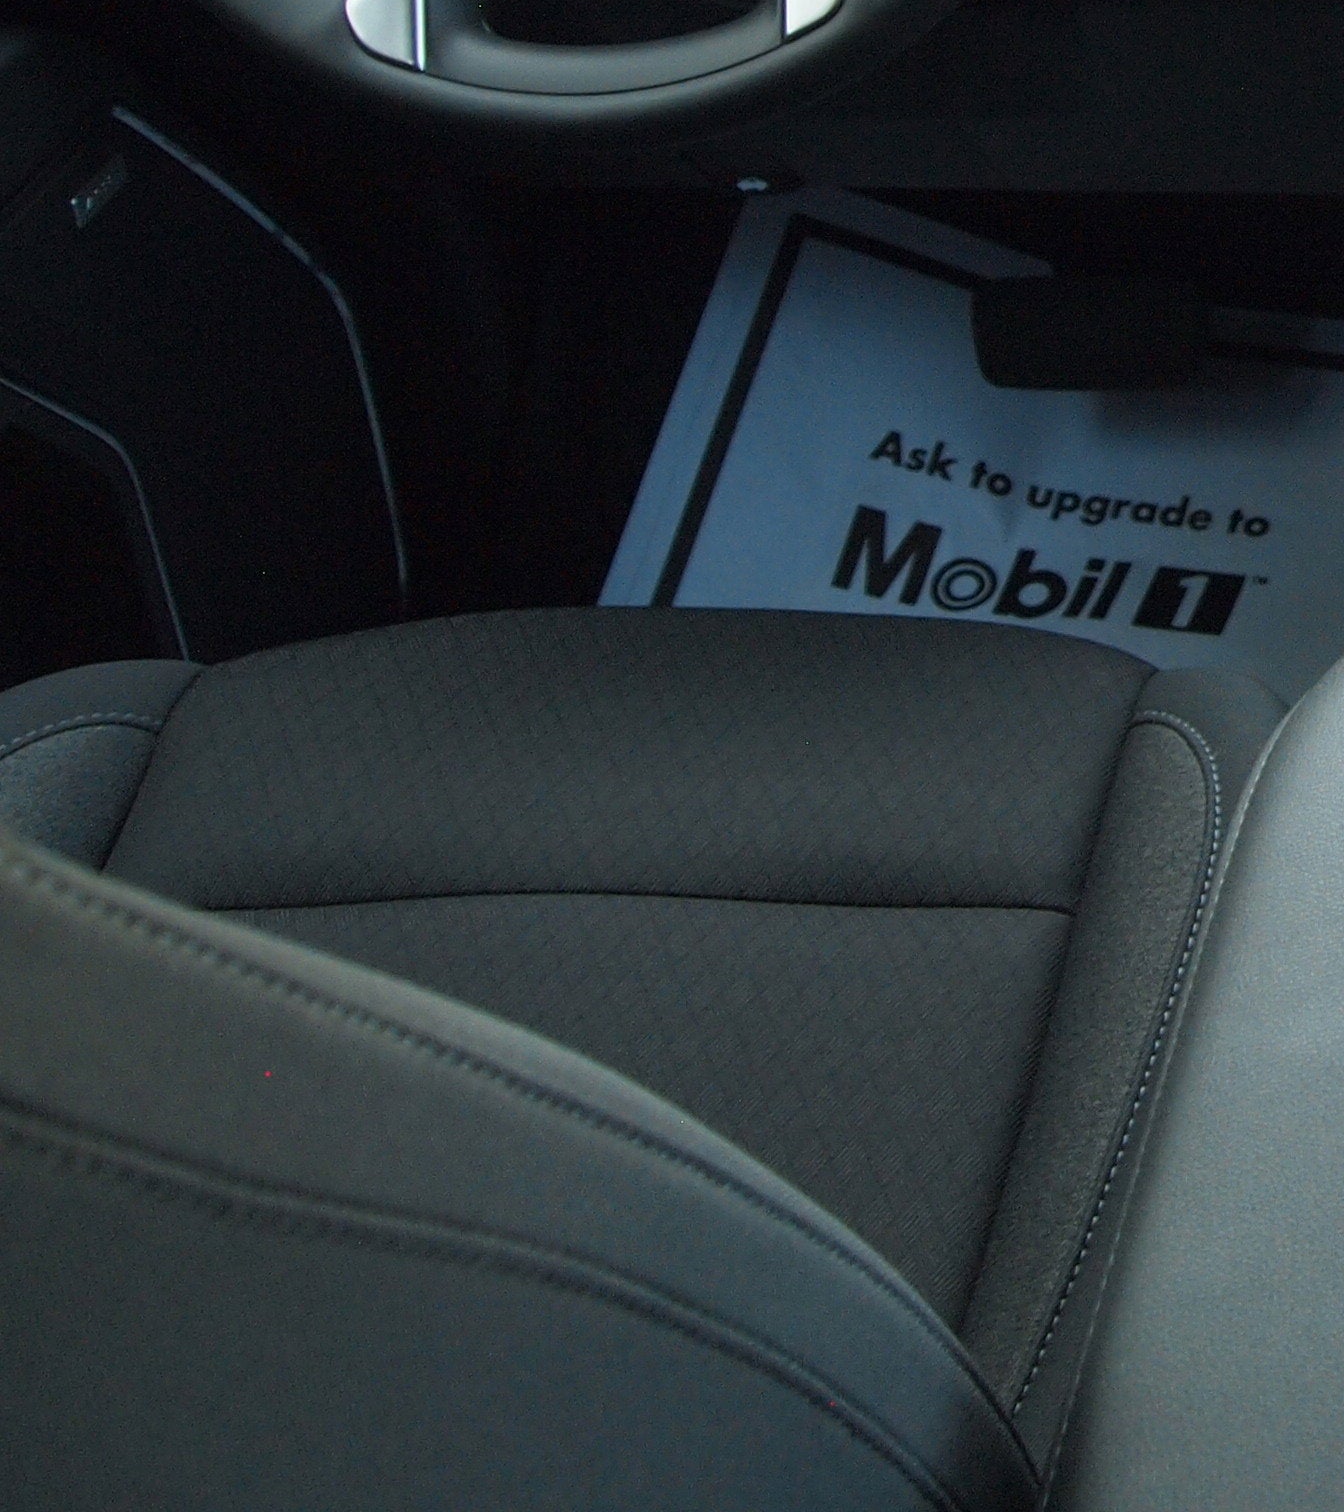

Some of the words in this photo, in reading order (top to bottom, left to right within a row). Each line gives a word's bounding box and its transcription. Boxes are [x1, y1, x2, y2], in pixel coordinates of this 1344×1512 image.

[868, 430, 960, 482] Ask
[971, 459, 1013, 498] to
[1026, 483, 1213, 533] upgrade
[1227, 506, 1271, 538] to
[831, 504, 1132, 621] Mobil
